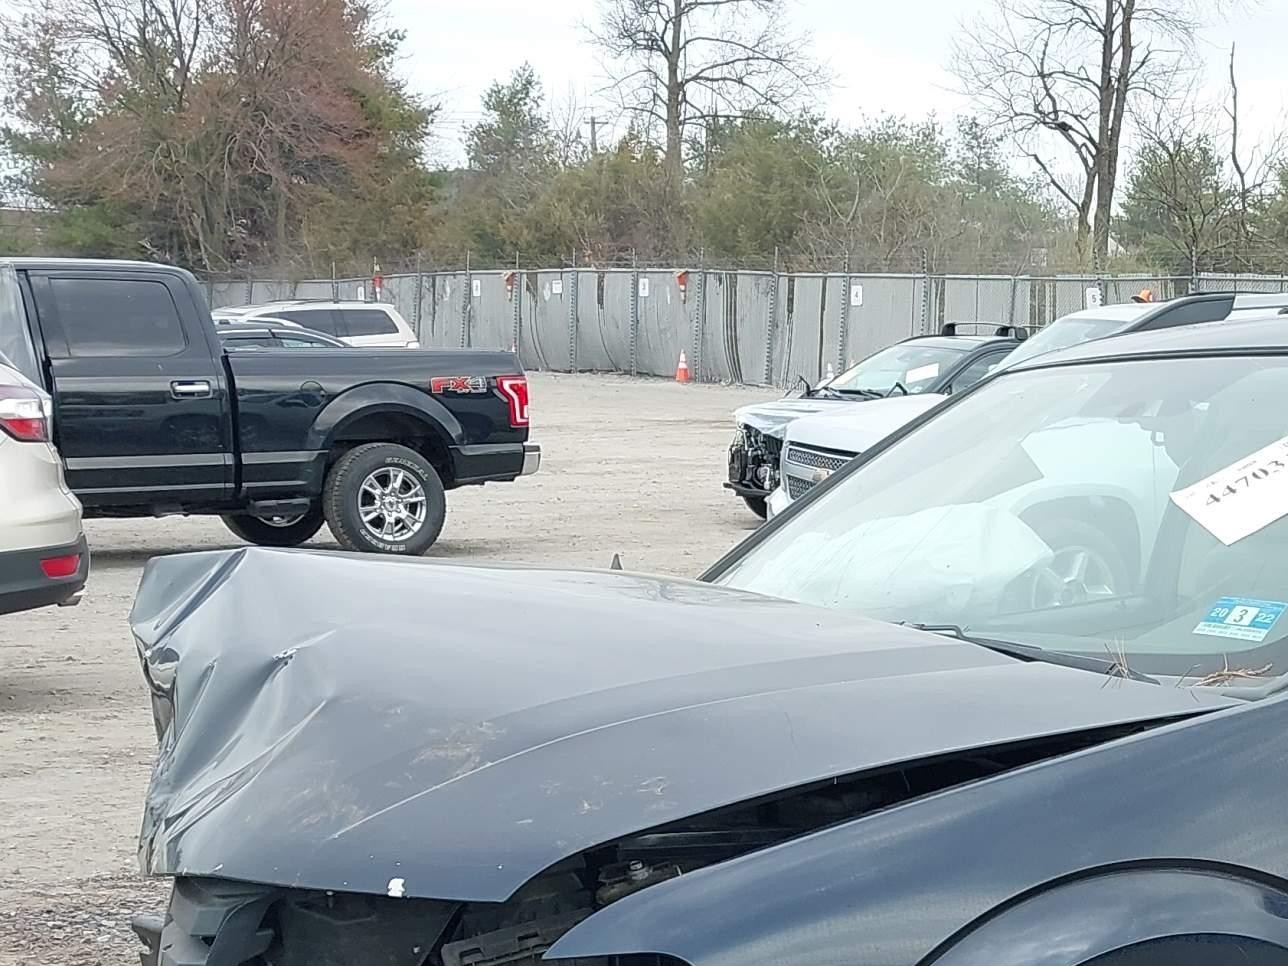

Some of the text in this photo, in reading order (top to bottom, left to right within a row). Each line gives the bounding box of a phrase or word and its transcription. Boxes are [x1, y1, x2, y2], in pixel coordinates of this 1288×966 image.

[1091, 294, 1097, 304] 5
[430, 376, 487, 394] FX4
[1210, 607, 1275, 624] 20 3 22
